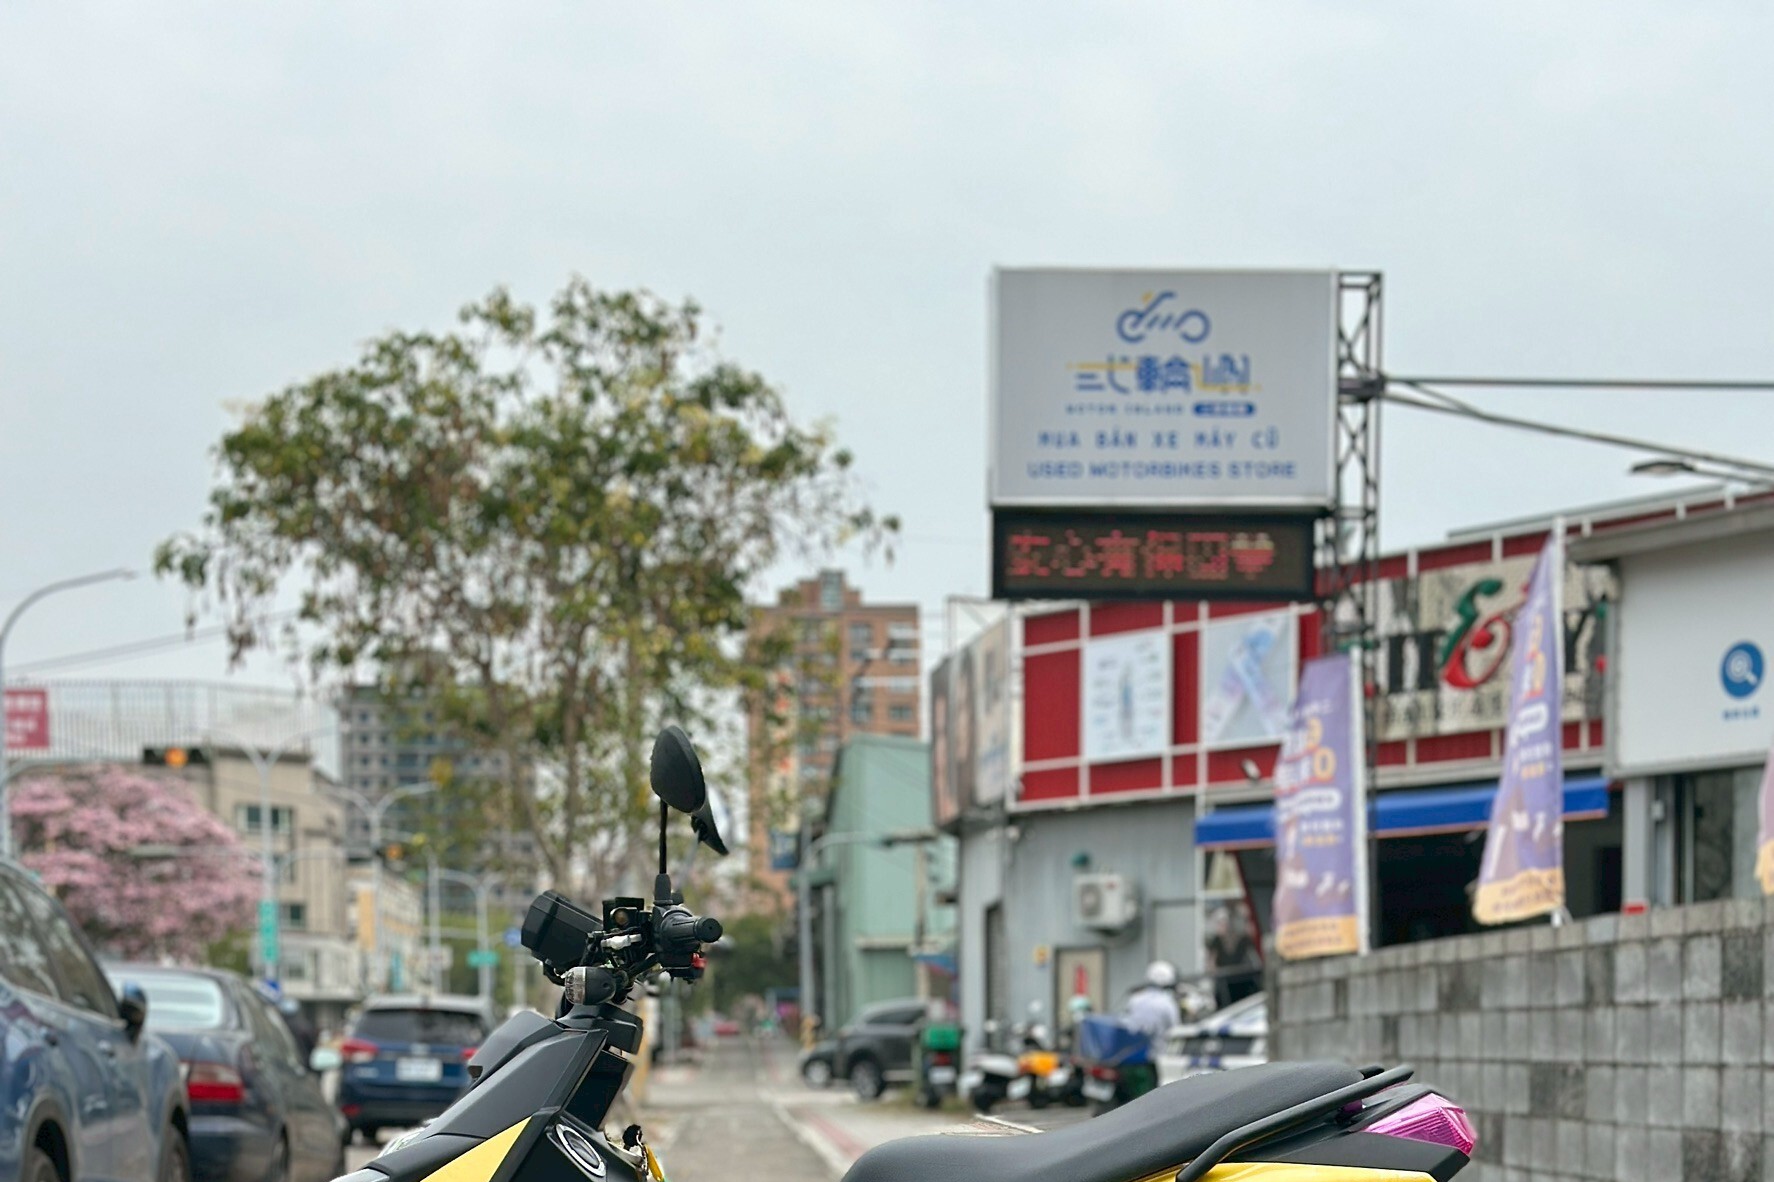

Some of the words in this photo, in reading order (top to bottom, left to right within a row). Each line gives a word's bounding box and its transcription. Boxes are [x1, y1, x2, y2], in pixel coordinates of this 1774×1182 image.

[1026, 460, 1084, 480] USED
[1089, 460, 1222, 480] MOTORBIKES
[1228, 460, 1297, 480] STORE
